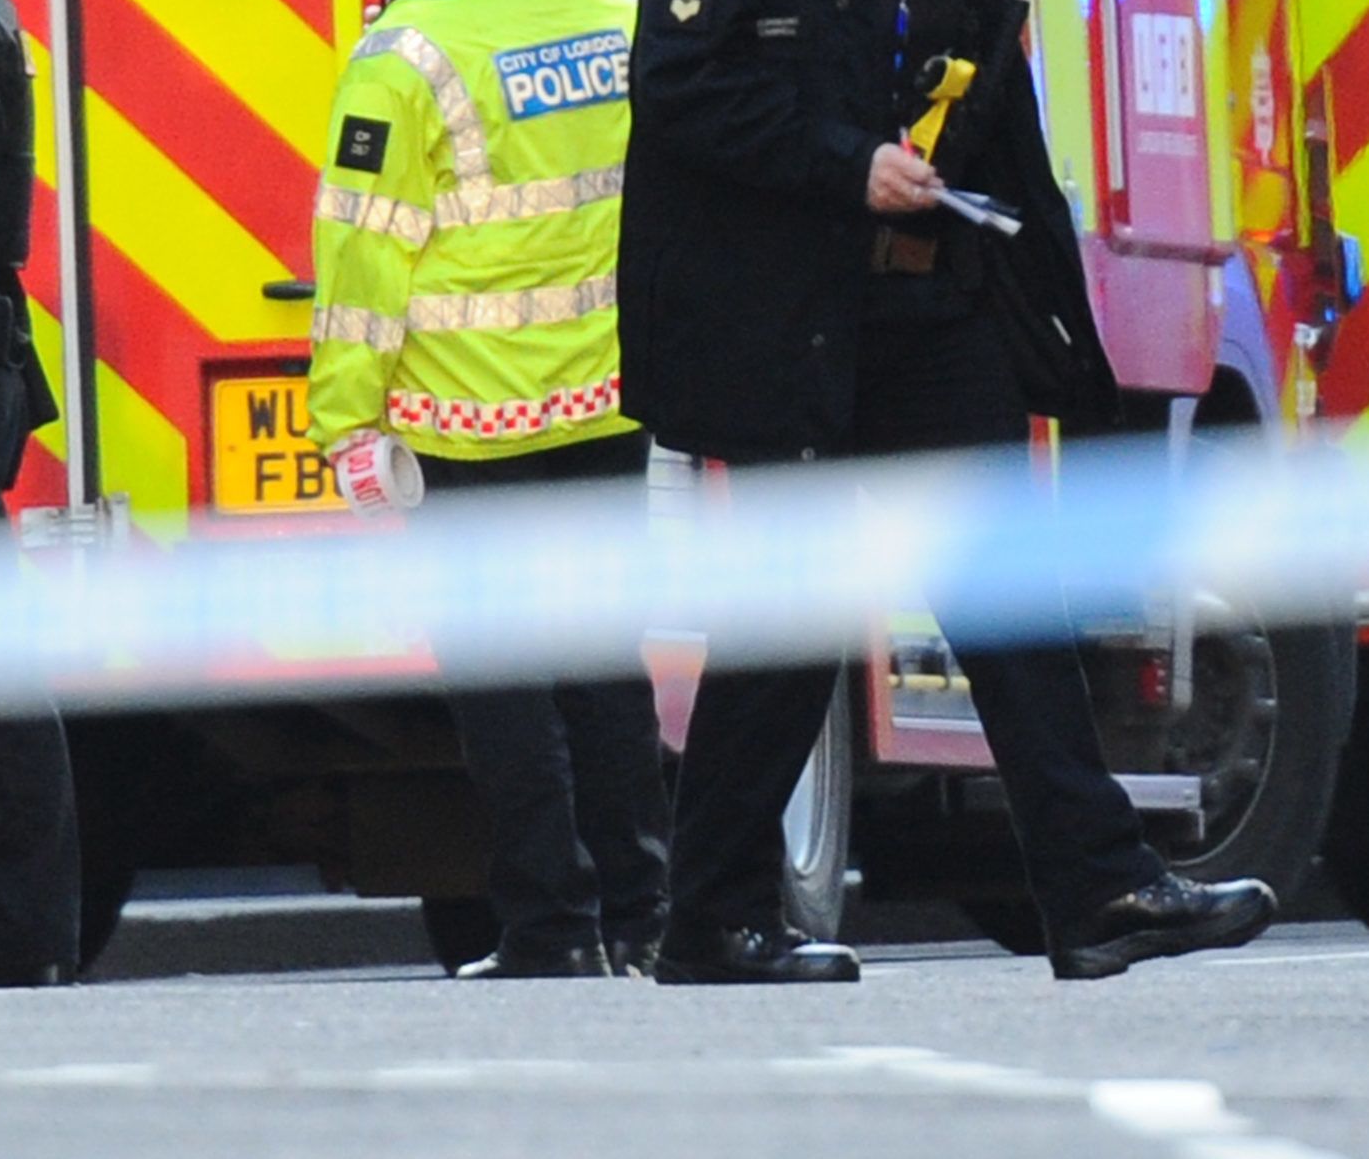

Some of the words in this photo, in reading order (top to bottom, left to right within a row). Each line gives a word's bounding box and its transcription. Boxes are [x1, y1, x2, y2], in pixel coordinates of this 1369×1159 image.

[499, 50, 538, 72] CITY
[539, 44, 562, 64] OF
[562, 34, 629, 60] LONDON
[506, 51, 631, 114] POLICE
